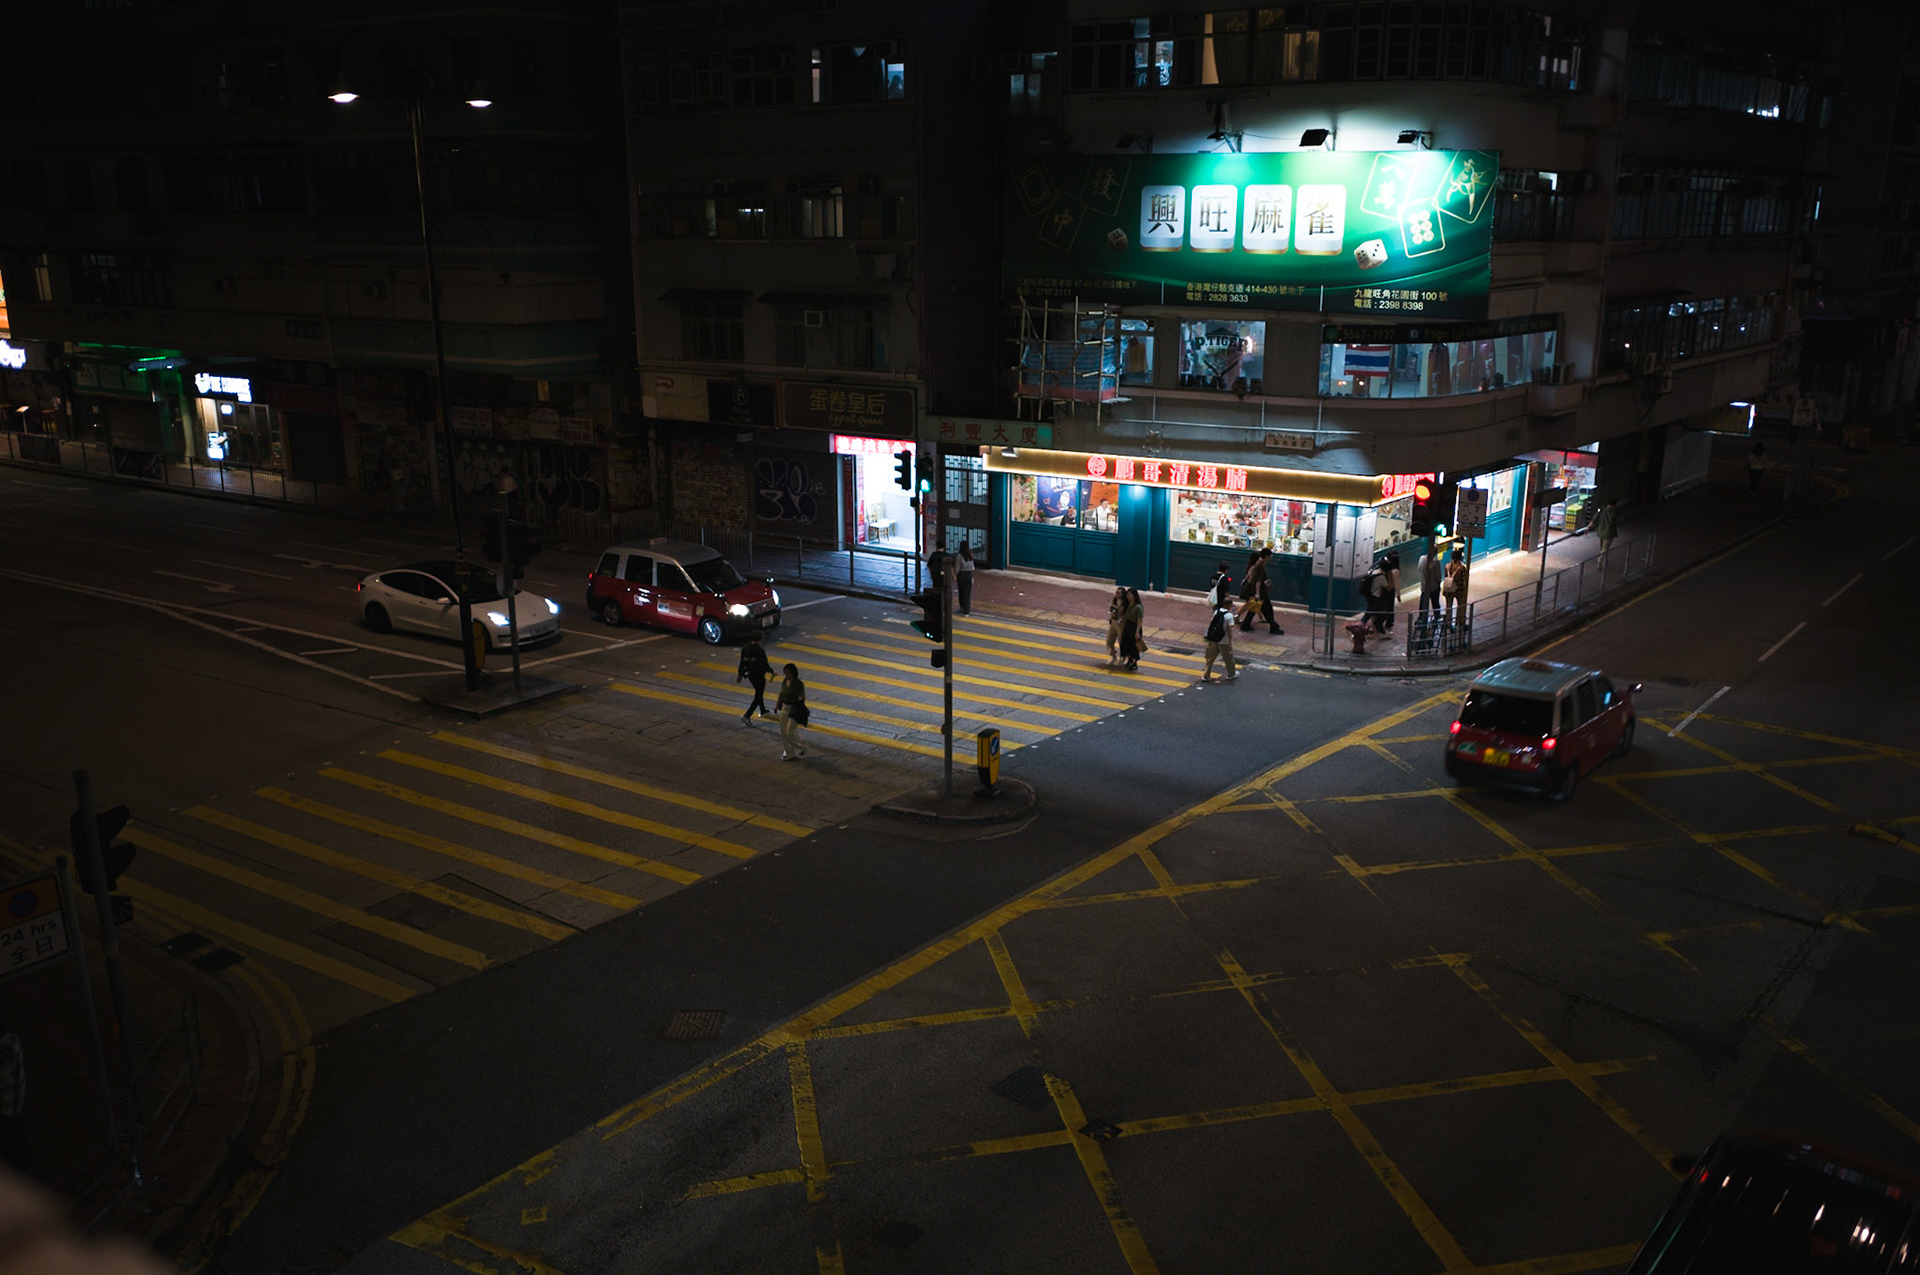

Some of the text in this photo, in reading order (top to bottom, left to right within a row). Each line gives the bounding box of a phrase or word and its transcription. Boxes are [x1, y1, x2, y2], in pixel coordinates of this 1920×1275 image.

[1148, 193, 1335, 236] 興旺麻雀
[1245, 285, 1278, 294] 414-430
[1208, 293, 1228, 302] 2828
[1229, 294, 1249, 303] 3633
[1421, 291, 1437, 301] 100
[1379, 300, 1400, 309] 2398
[1402, 301, 1424, 311] 8398
[857, 416, 885, 428] Queen
[1114, 458, 1248, 492] 鵬哥清湯腩
[1, 920, 56, 947] 24 hrs
[11, 936, 53, 965] 全日
